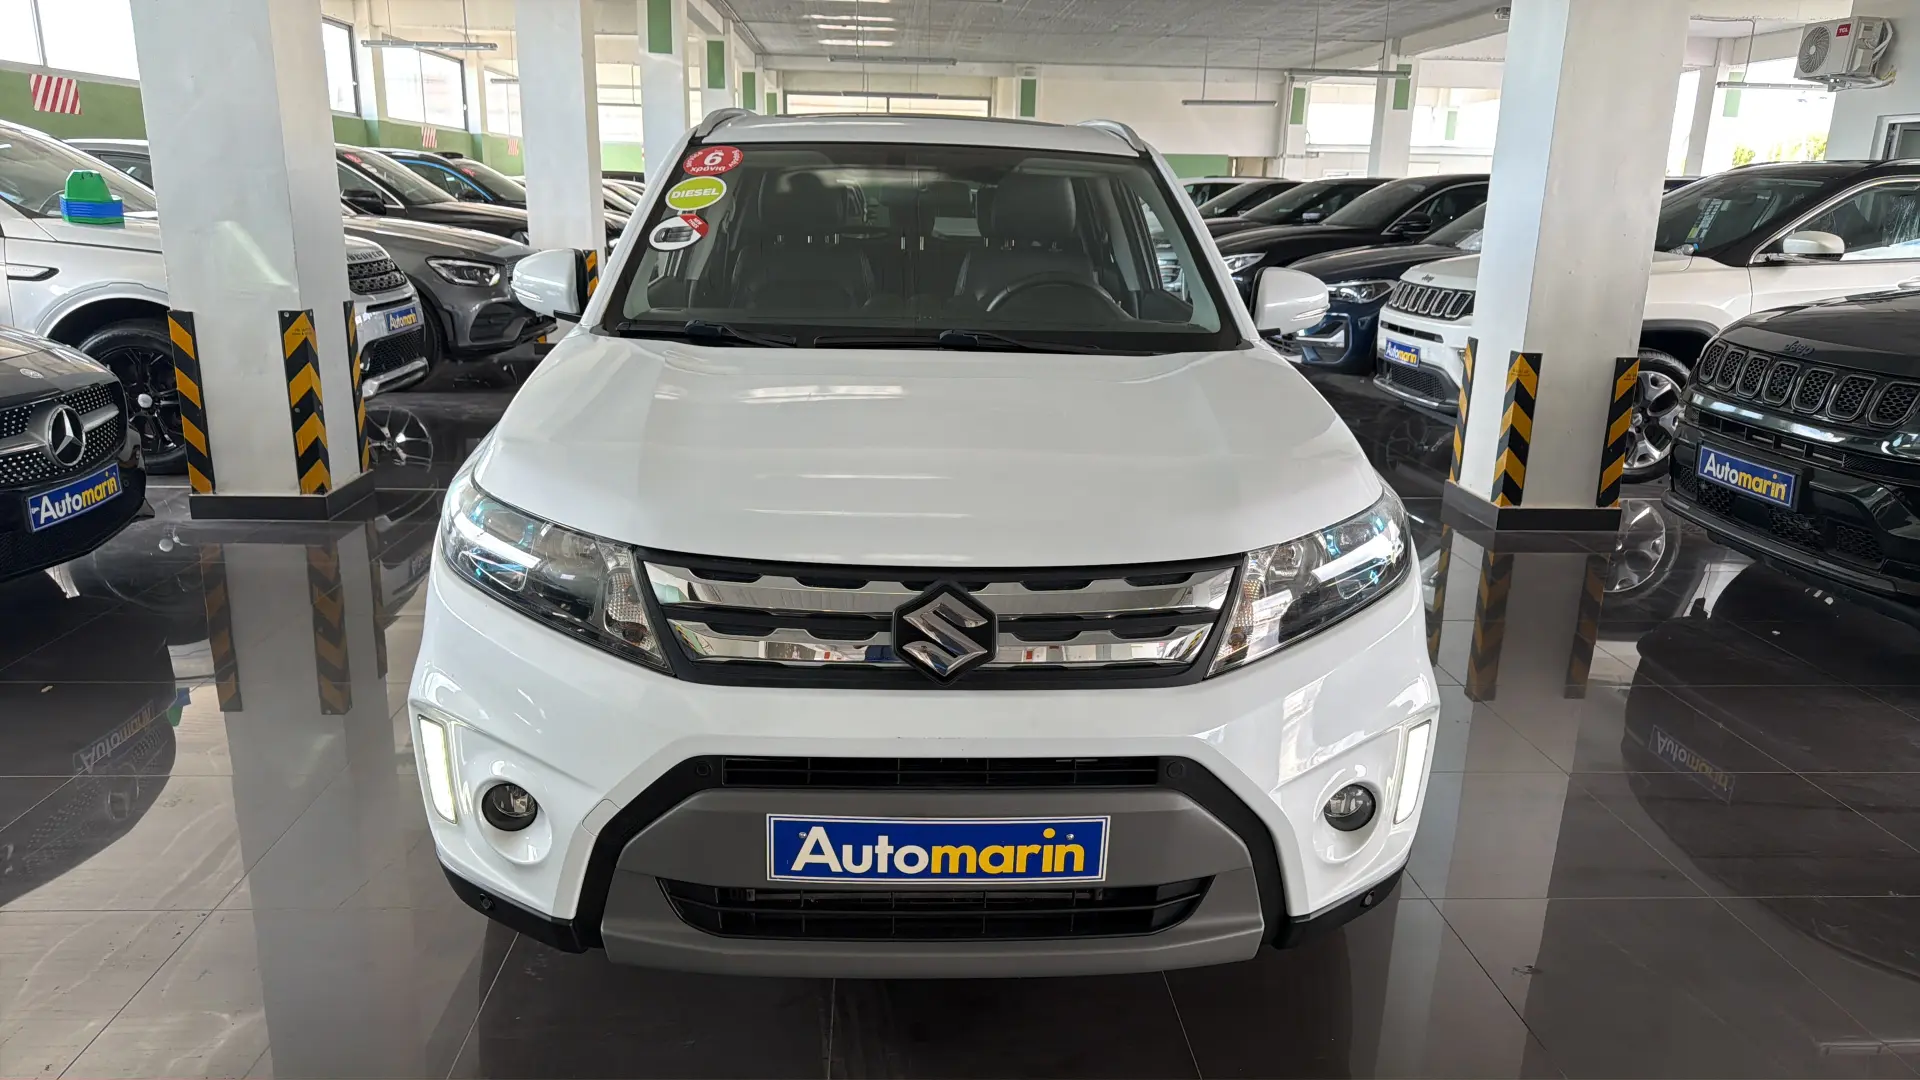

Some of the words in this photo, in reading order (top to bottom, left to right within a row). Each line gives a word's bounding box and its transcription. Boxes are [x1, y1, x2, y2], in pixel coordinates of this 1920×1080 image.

[704, 151, 724, 166] 6
[671, 188, 720, 199] DIESEL
[389, 307, 417, 330] Automarin
[1386, 341, 1417, 364] Automarin
[1784, 340, 1815, 356] Jeep
[1704, 453, 1787, 501] Automarin
[40, 471, 118, 525] Automarin
[791, 826, 1085, 875] Automarin
